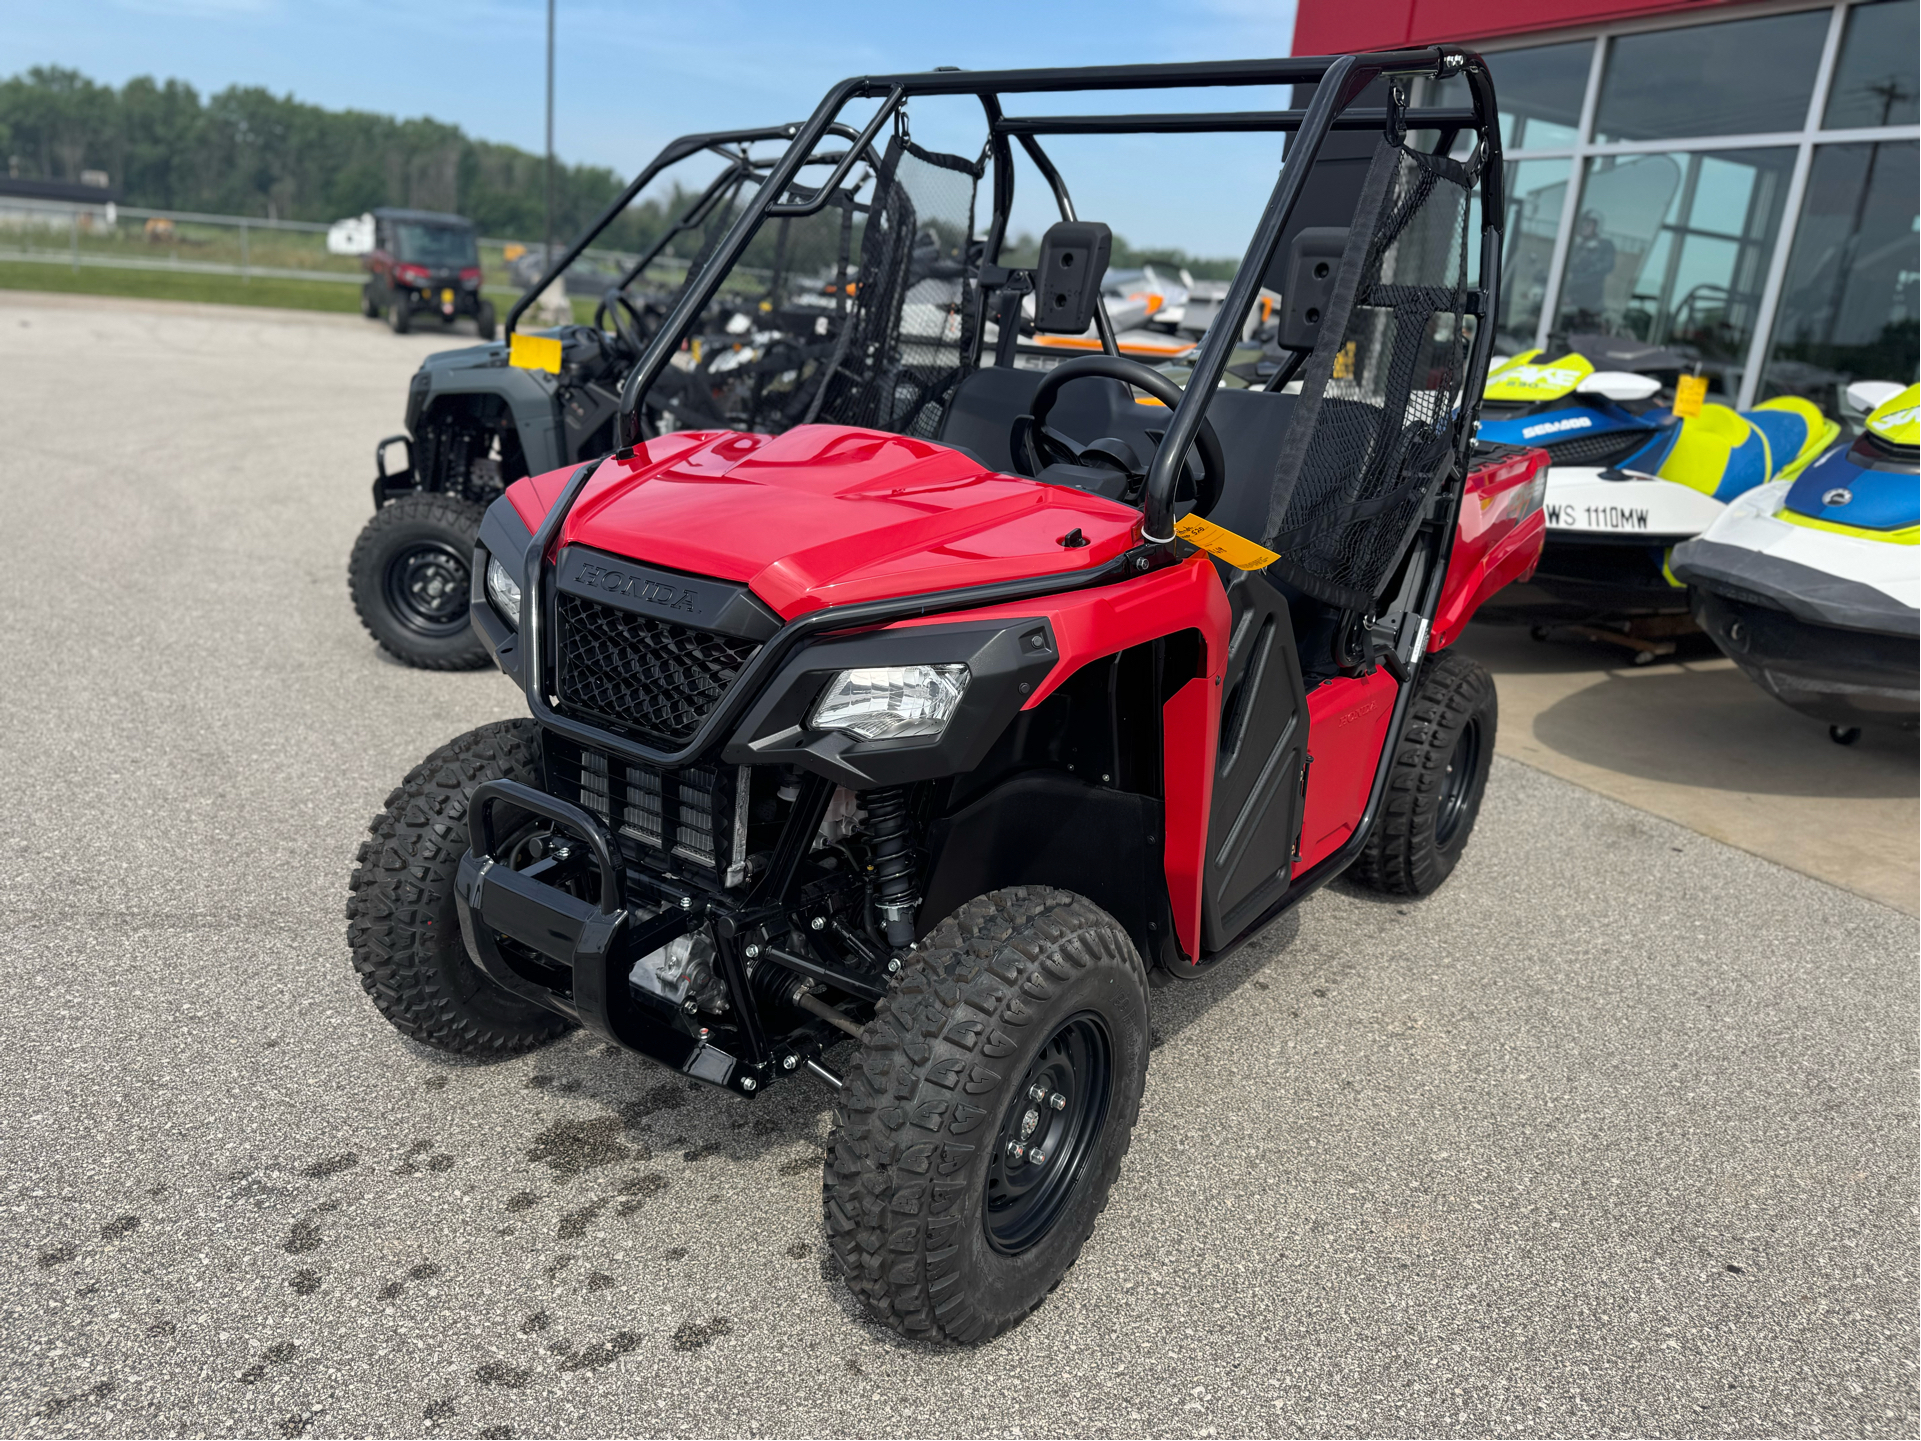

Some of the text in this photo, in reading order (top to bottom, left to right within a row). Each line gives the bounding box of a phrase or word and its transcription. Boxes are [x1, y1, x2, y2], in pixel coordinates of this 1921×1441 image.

[1546, 504, 1576, 526] WS
[573, 562, 699, 613] HONDA
[1338, 700, 1378, 728] HONDA
